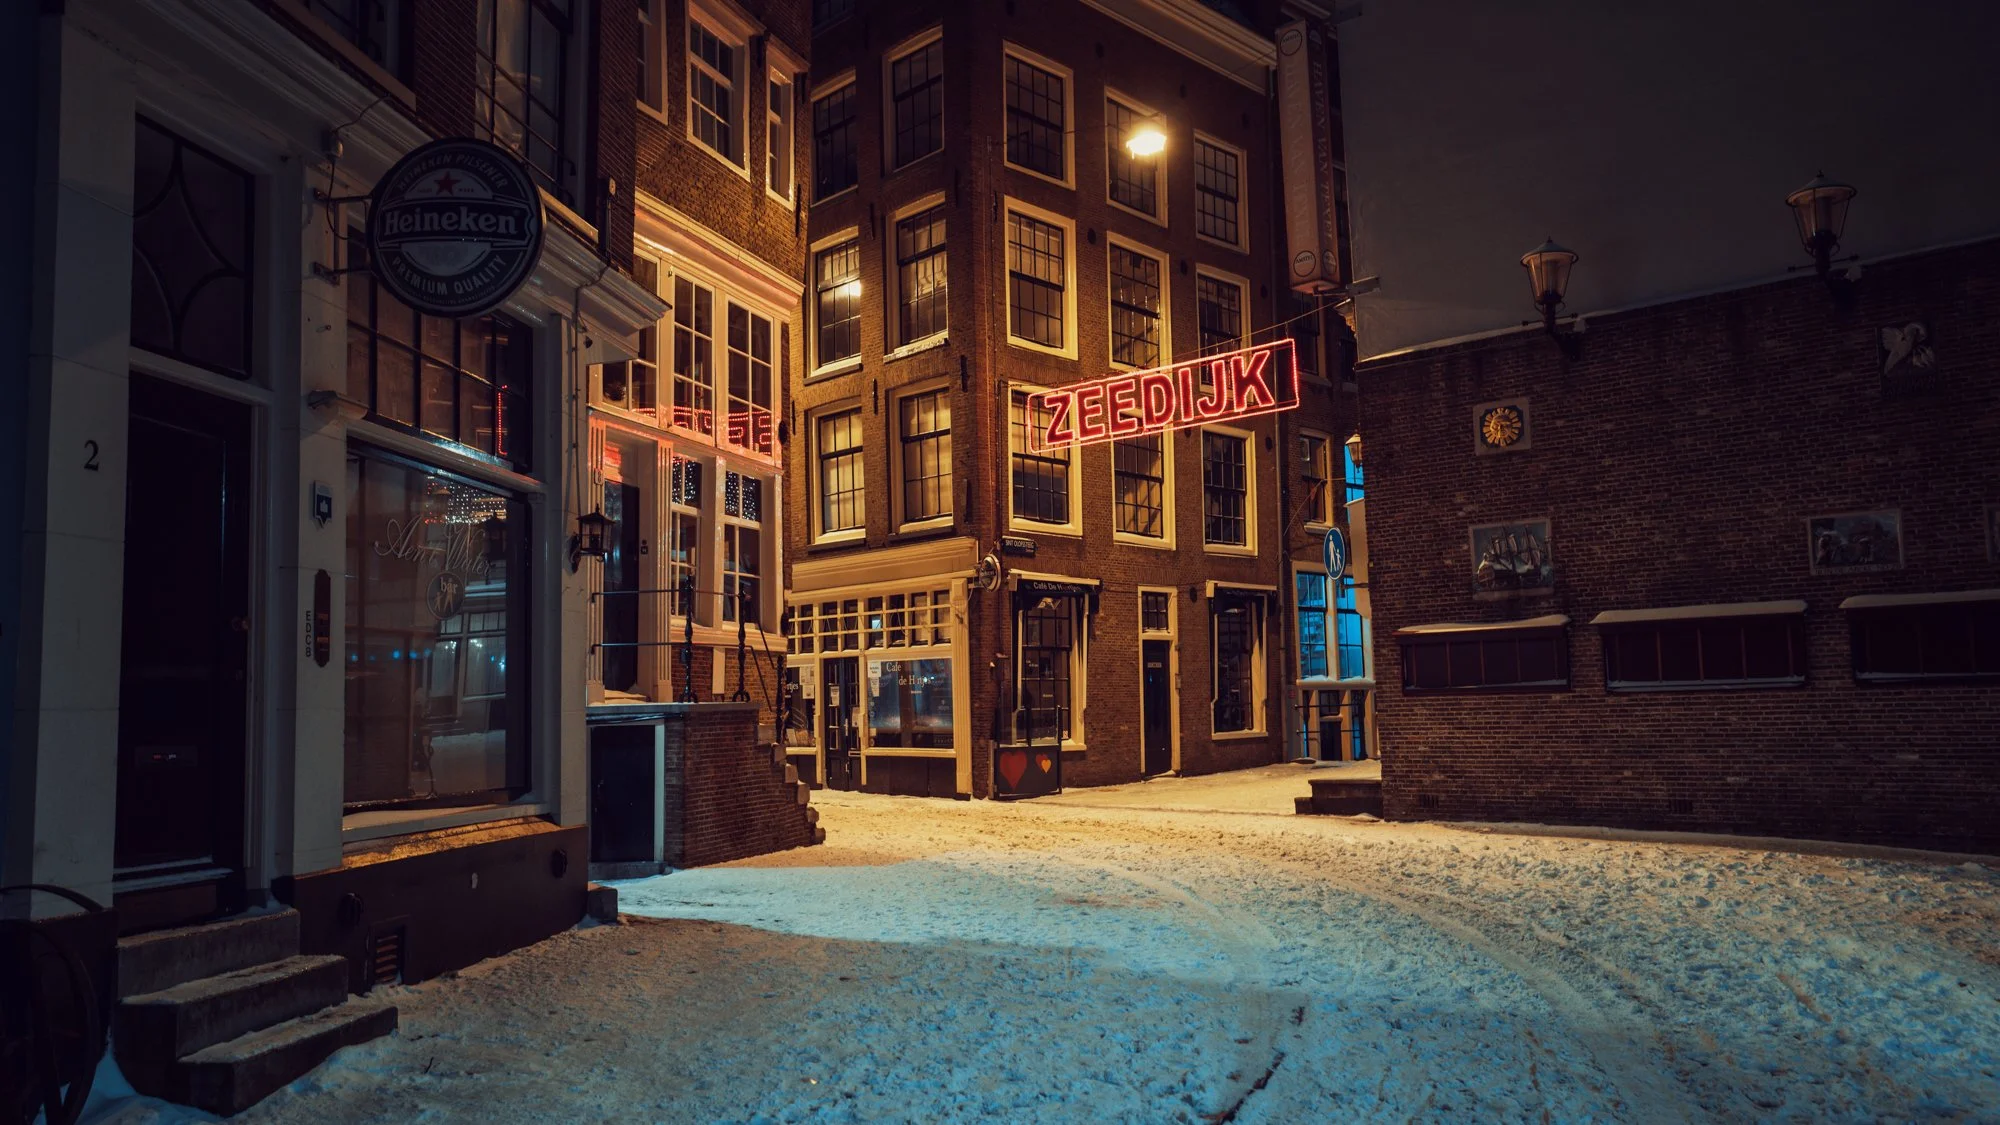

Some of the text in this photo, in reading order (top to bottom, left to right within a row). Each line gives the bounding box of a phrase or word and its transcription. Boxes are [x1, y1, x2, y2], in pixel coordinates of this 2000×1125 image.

[1312, 60, 1326, 128] HAVEN
[456, 152, 509, 190] PILSENER
[1317, 137, 1329, 175] VAN
[385, 207, 518, 236] Heineken
[391, 255, 449, 296] PREMIUM
[454, 254, 508, 295] QUALITY
[1044, 349, 1276, 445] ZEEDIJK
[84, 440, 99, 471] 2
[898, 675, 907, 686] de
